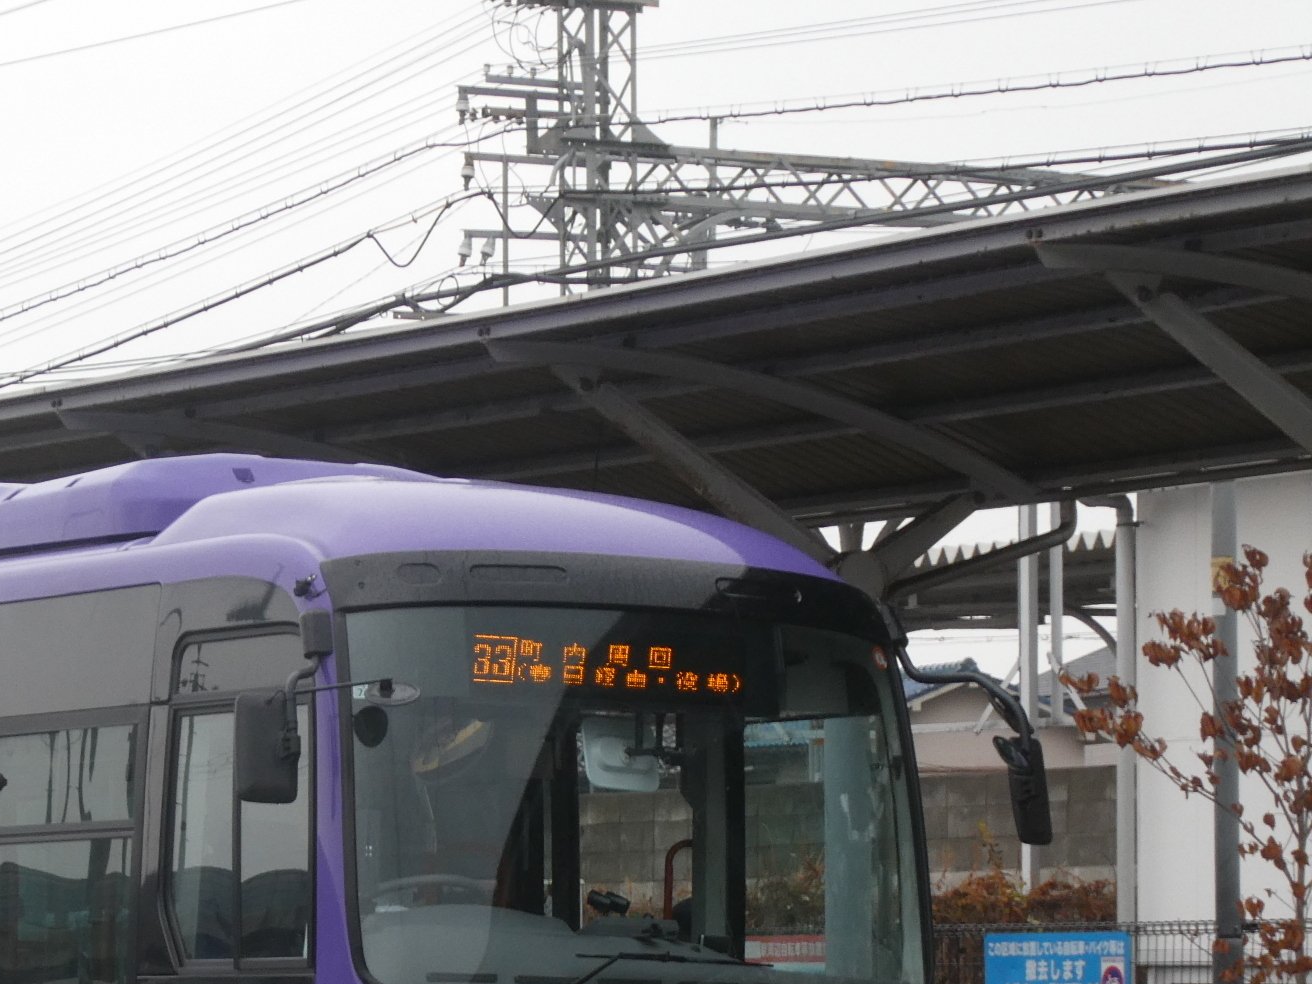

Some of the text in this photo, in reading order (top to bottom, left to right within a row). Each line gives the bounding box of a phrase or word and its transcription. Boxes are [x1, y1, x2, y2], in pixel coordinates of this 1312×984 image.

[474, 643, 512, 675] 33
[1025, 959, 1086, 981] 撤去します
